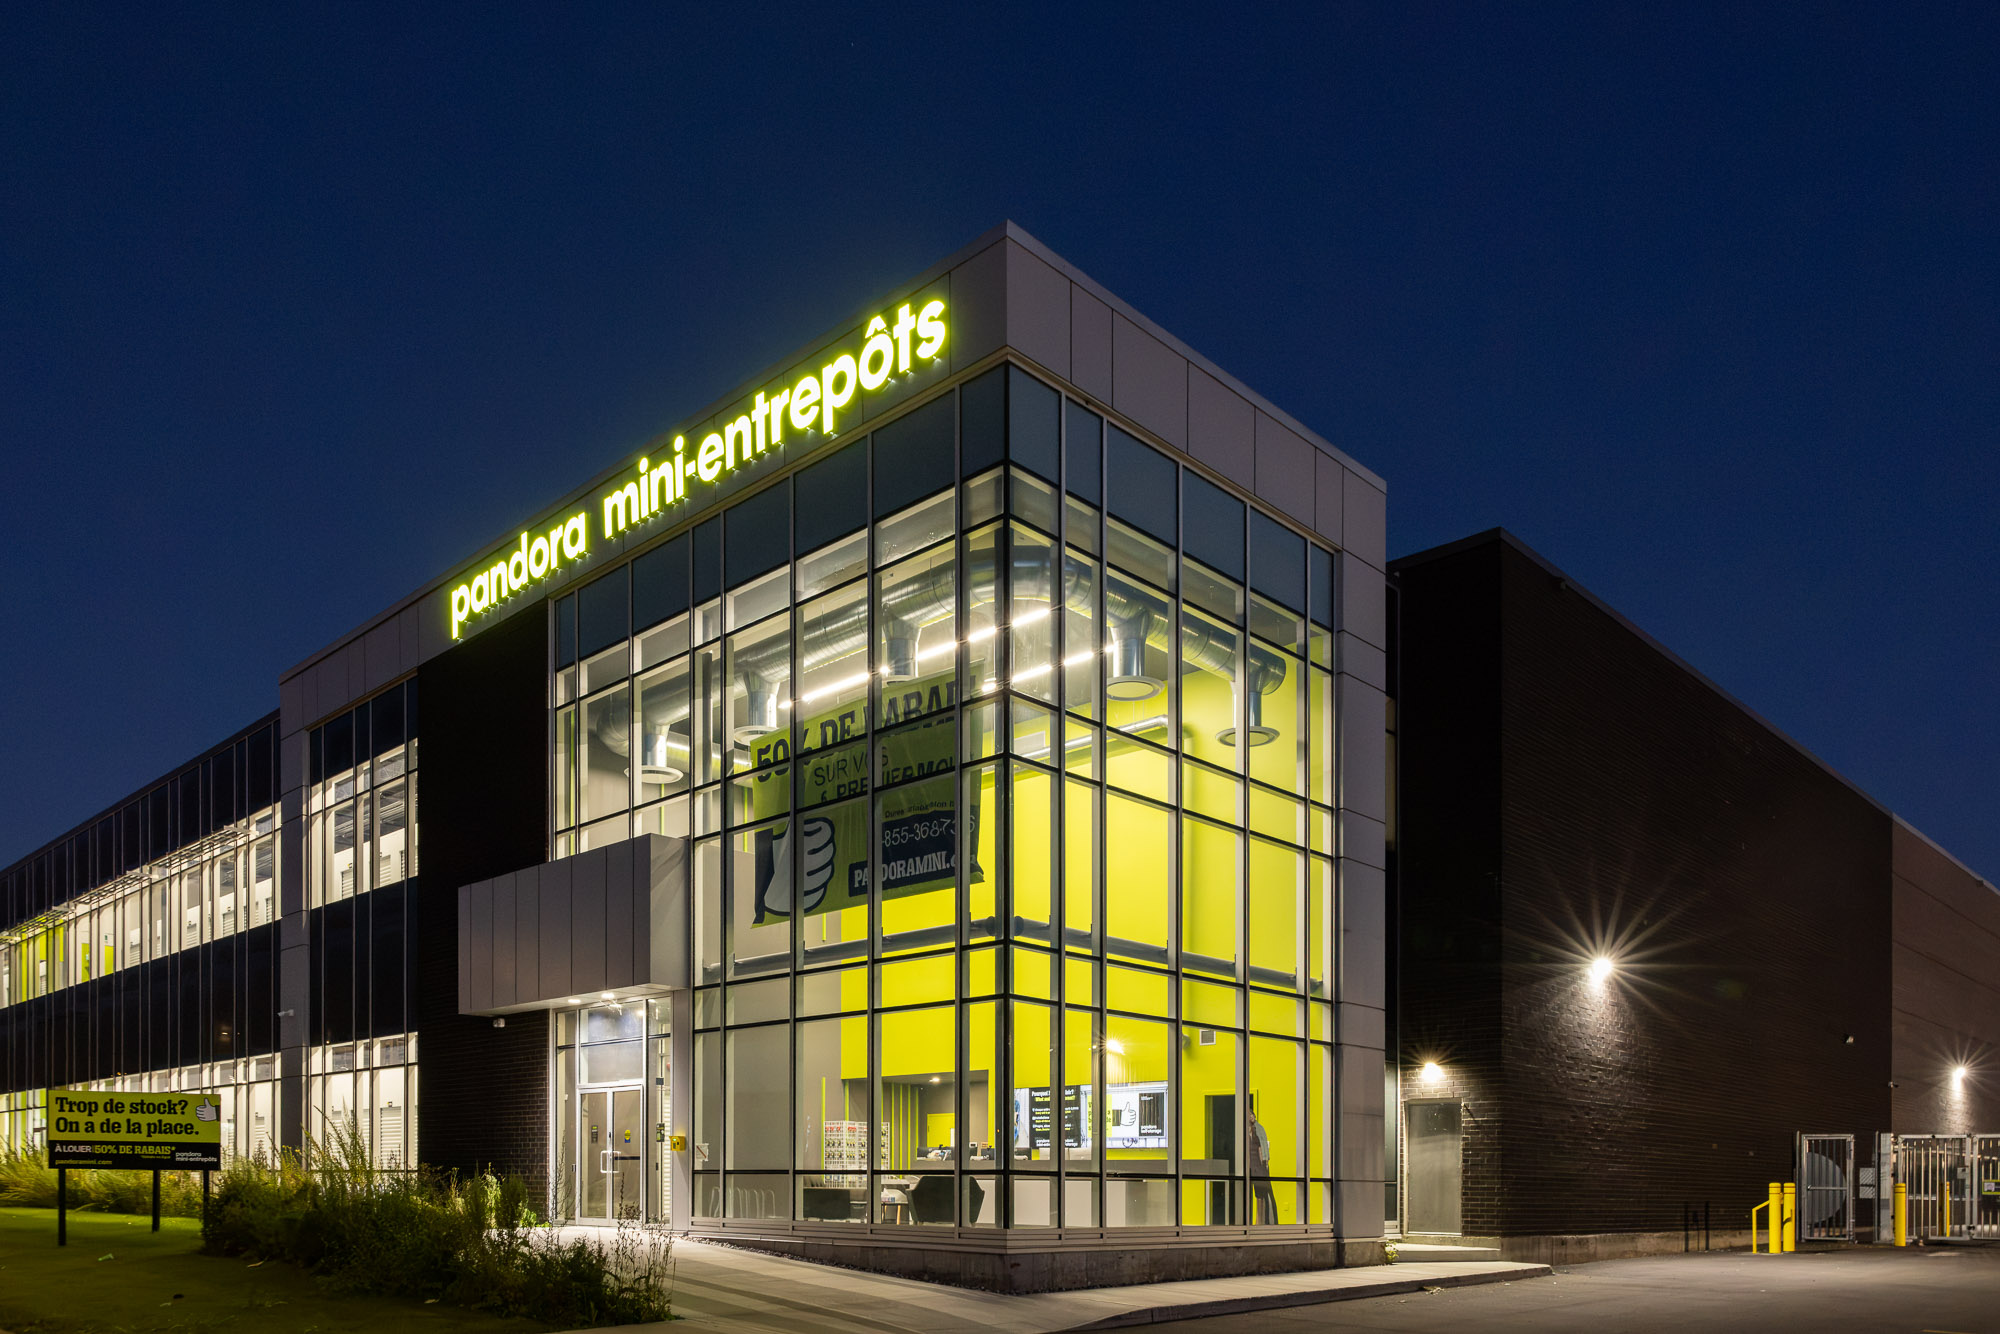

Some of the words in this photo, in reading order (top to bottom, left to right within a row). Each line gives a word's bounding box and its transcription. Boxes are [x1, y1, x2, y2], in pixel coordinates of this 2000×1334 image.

[450, 511, 587, 640] pandora
[604, 299, 947, 540] mini-entrepôts
[820, 710, 856, 758] DE
[814, 757, 849, 788] SUR
[55, 1097, 99, 1117] Trop
[103, 1098, 125, 1114] de
[129, 1099, 188, 1115] stock?
[55, 1117, 80, 1133] On
[84, 1121, 96, 1134] a
[100, 1118, 122, 1134] de
[126, 1118, 142, 1134] la
[146, 1119, 199, 1138] place.
[54, 1143, 62, 1153] À
[63, 1145, 92, 1153] LOUER
[94, 1144, 117, 1154] 50%
[119, 1145, 133, 1154] DE
